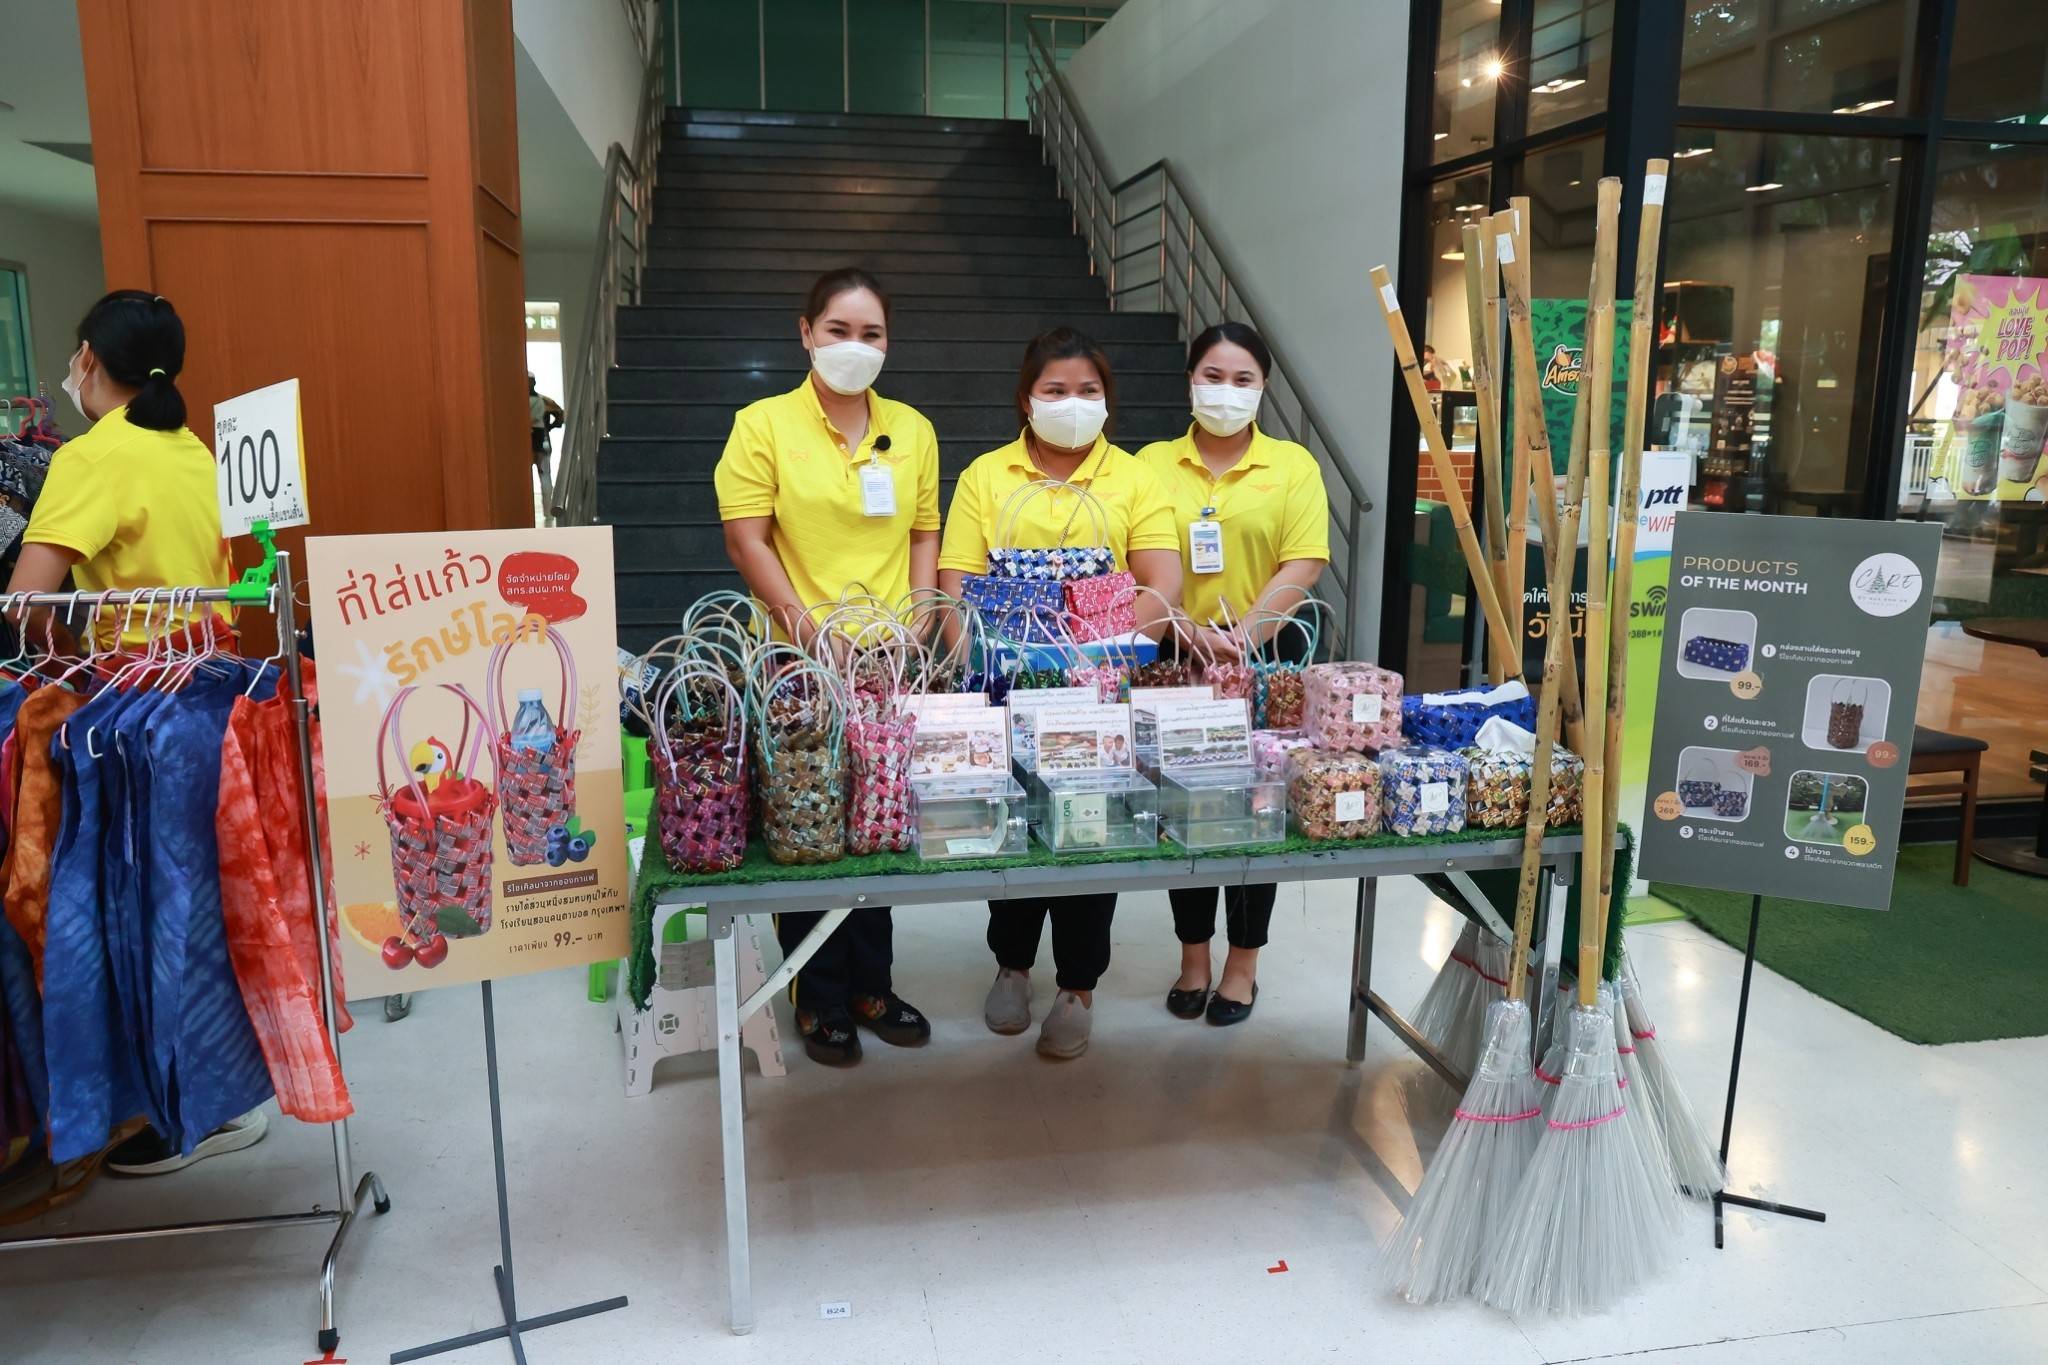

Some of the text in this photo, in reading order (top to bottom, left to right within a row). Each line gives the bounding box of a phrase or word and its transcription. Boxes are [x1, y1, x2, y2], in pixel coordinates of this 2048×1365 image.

[1997, 317, 2033, 337] LOVE
[1995, 335, 2034, 361] POP!
[221, 429, 292, 506] 100.-
[1644, 485, 1683, 509] ptt
[1683, 556, 1799, 576] PRODUCTS
[336, 548, 492, 625] ที่ใส่แก้ว
[505, 571, 571, 584] จัดจำหน่ายโดย
[1680, 575, 1808, 595] OF THE MONTH
[383, 599, 549, 686] รักษ์โลก
[1737, 680, 1761, 691] 99.-
[1849, 836, 1874, 846] 159.-
[507, 873, 595, 893] รีไซเคิลมาจากซองกาแฟ
[553, 931, 583, 948] 99.-
[587, 931, 603, 942] บาท
